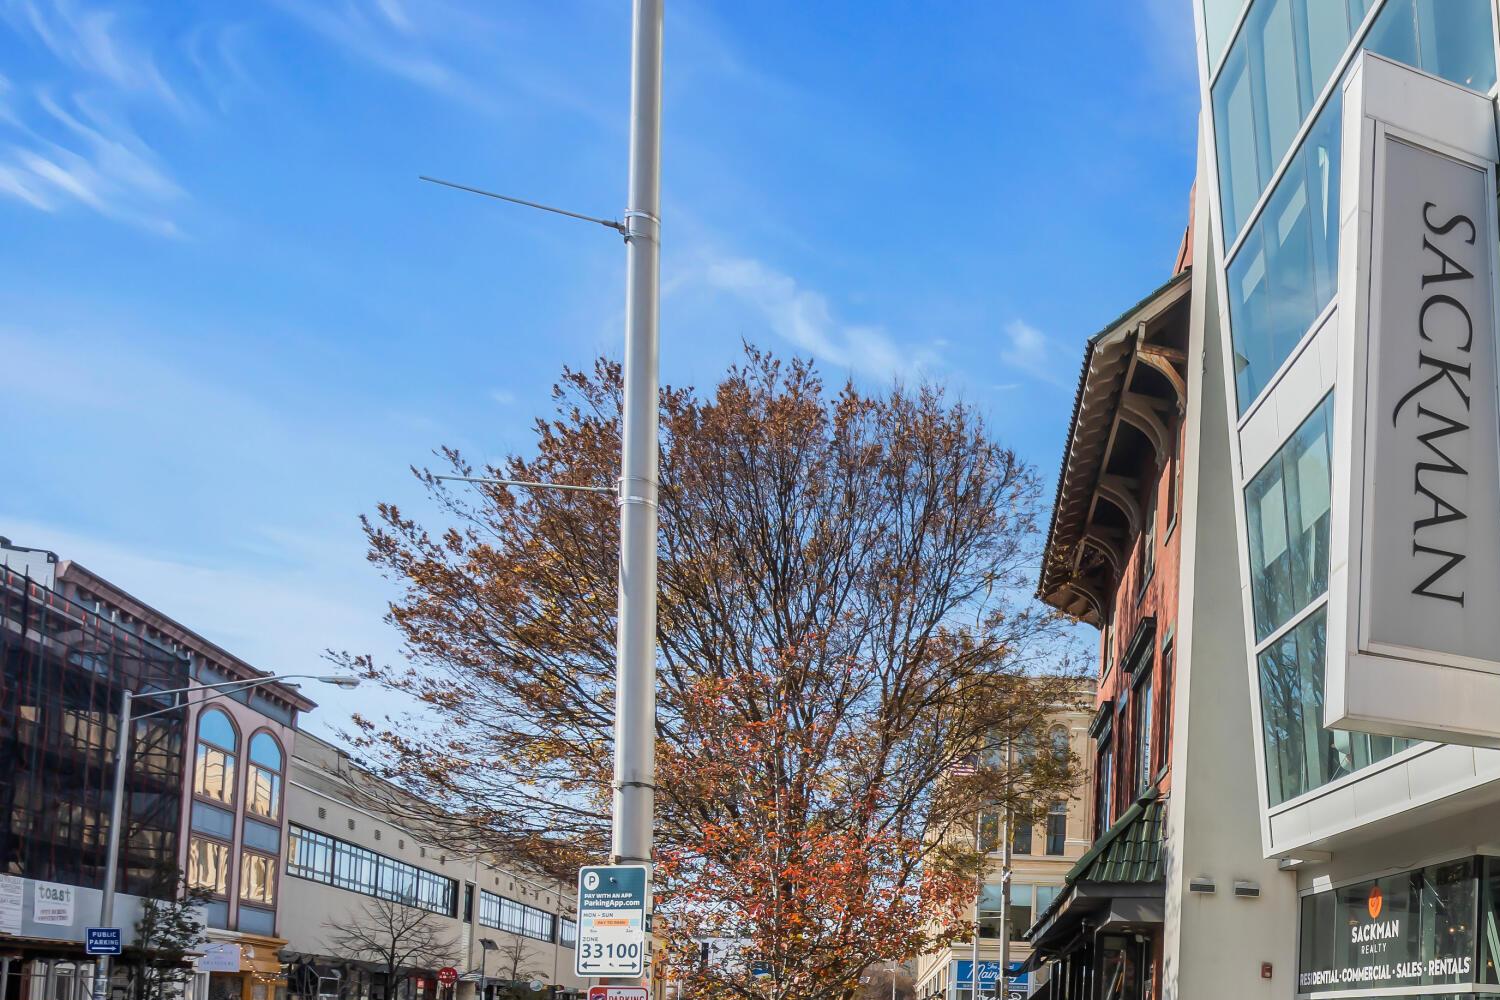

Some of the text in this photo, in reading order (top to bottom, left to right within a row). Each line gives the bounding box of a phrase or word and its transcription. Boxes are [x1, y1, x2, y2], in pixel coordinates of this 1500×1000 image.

[1392, 201, 1477, 609] SACKMAN
[38, 885, 71, 902] toast
[1351, 919, 1400, 944] SACKMAN
[582, 943, 638, 959] 33100
[1360, 943, 1387, 955] REALTY
[1396, 961, 1423, 979] SALES
[1428, 956, 1472, 976] RENTALS
